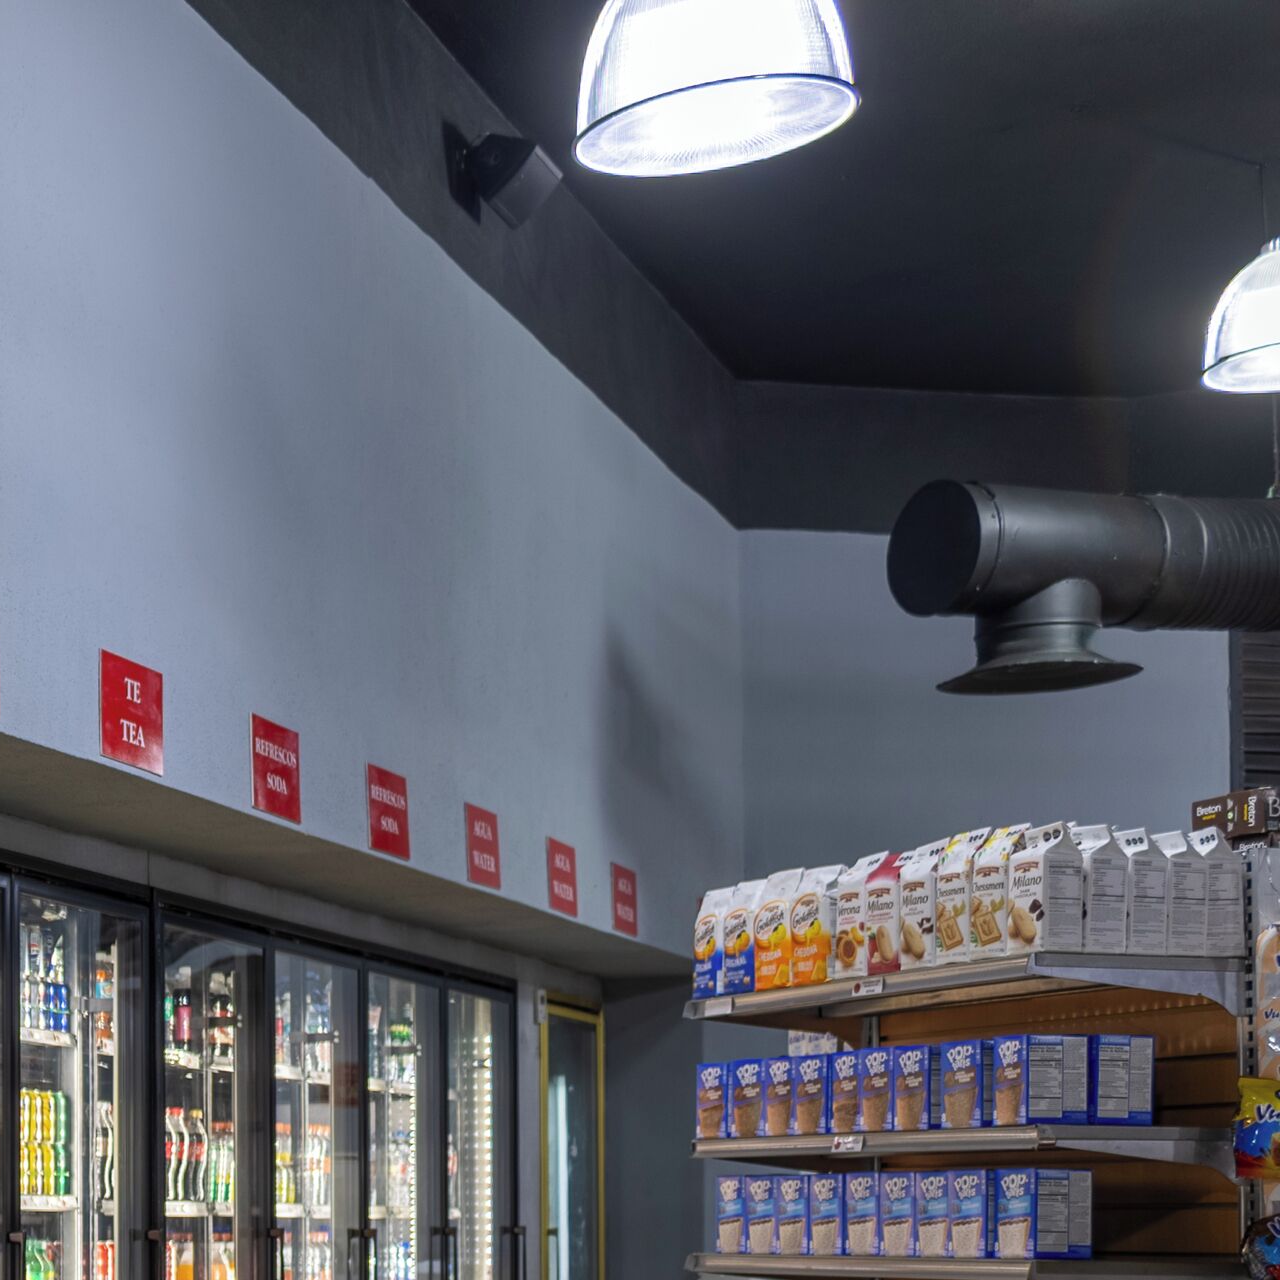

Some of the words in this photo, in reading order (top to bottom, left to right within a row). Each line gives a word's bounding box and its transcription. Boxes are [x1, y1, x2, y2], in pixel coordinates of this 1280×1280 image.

[124, 677, 141, 704] TE
[120, 718, 145, 748] TEA
[255, 737, 297, 768] REFRESCOS
[266, 772, 287, 795] SODA
[370, 784, 405, 810] REFRESCOS
[1197, 804, 1221, 816] Breton
[1247, 796, 1257, 827] Breton
[380, 815, 399, 835] SODA
[473, 820, 492, 840] AGUA
[473, 850, 496, 873] WATER
[1012, 876, 1042, 890] Milano
[866, 900, 894, 911] Milano
[902, 895, 928, 906] Milano
